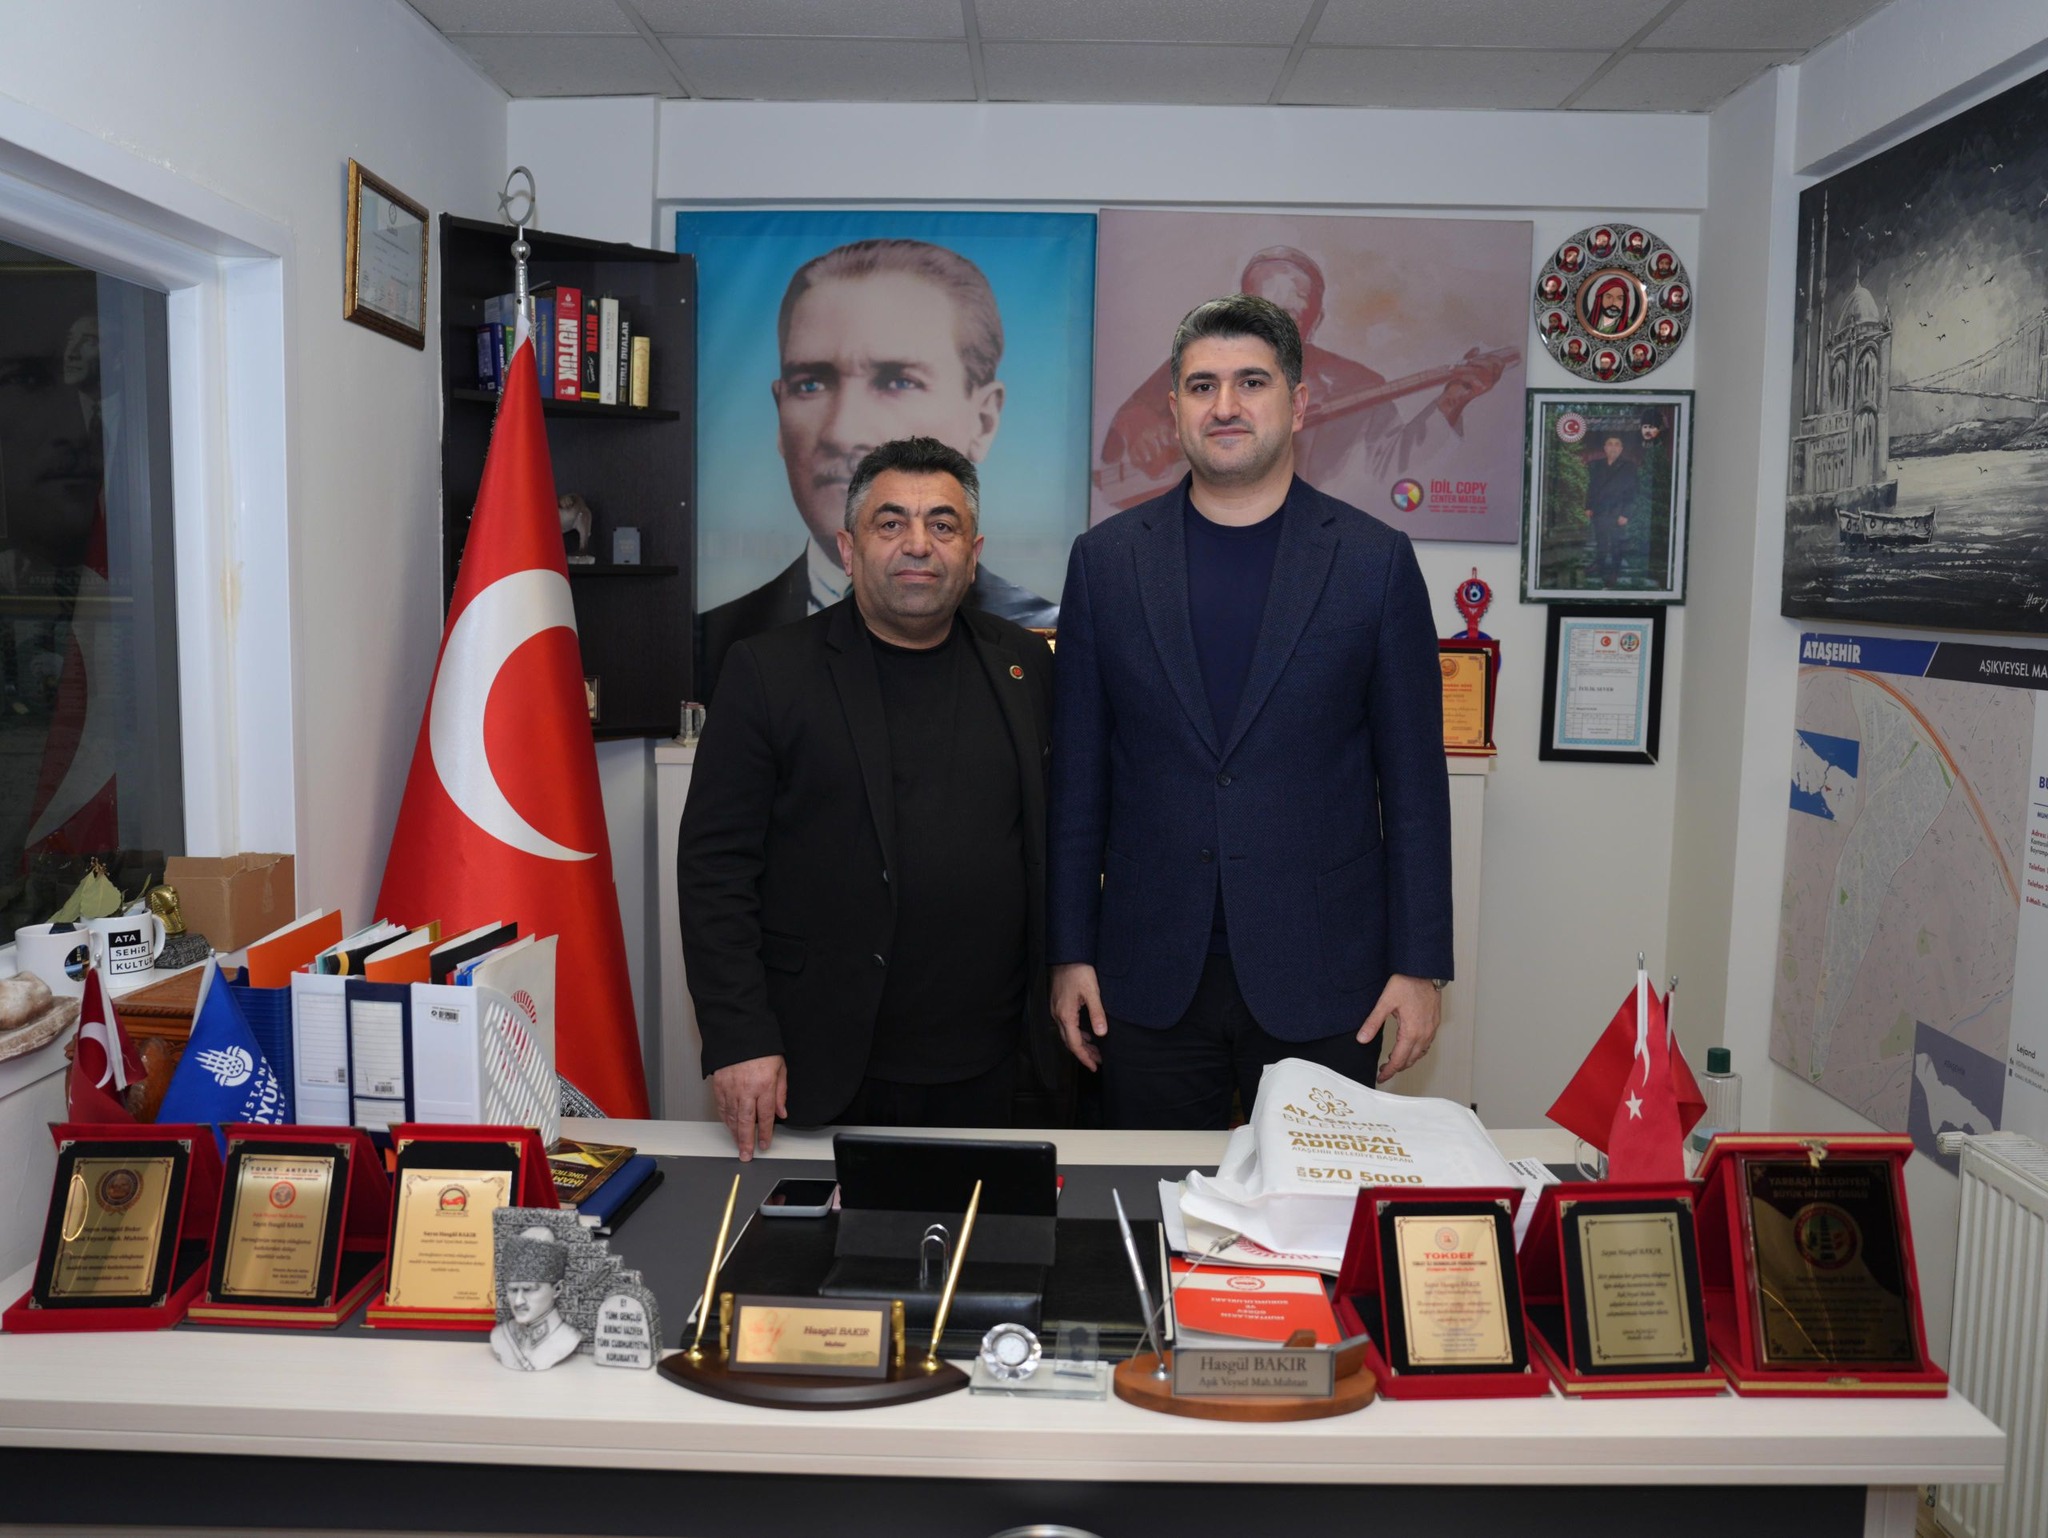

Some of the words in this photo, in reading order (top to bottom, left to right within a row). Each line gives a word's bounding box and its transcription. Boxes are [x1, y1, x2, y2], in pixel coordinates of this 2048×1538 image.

[586, 314, 598, 352] NUTUK
[620, 321, 629, 360] DUALAR
[559, 318, 578, 382] NUTUK
[1430, 478, 1453, 494] İDİL
[1456, 481, 1487, 494] COPY
[1803, 638, 1861, 665] ATAŞEHİR
[1979, 659, 2030, 677] AŞIKVEYSEL
[115, 934, 137, 943] ATA
[116, 956, 153, 971] KÜLTÜR
[240, 1056, 267, 1118] İSTANB
[1288, 1131, 1401, 1145] ONURSAL
[1291, 1138, 1411, 1157] ADIGÜZEL
[1292, 1146, 1332, 1155] ATAŞEHİR
[1333, 1149, 1374, 1159] BELEDİYE
[1376, 1153, 1414, 1164] BAŞKANI
[1308, 1167, 1353, 1180] 570
[1359, 1170, 1423, 1184] 5000
[803, 1326, 837, 1337] Hasgül
[839, 1327, 870, 1336] BAKIR
[1200, 1356, 1249, 1375] Hasgül
[1253, 1356, 1307, 1371] BAKIR
[1221, 1377, 1248, 1387] Veysel
